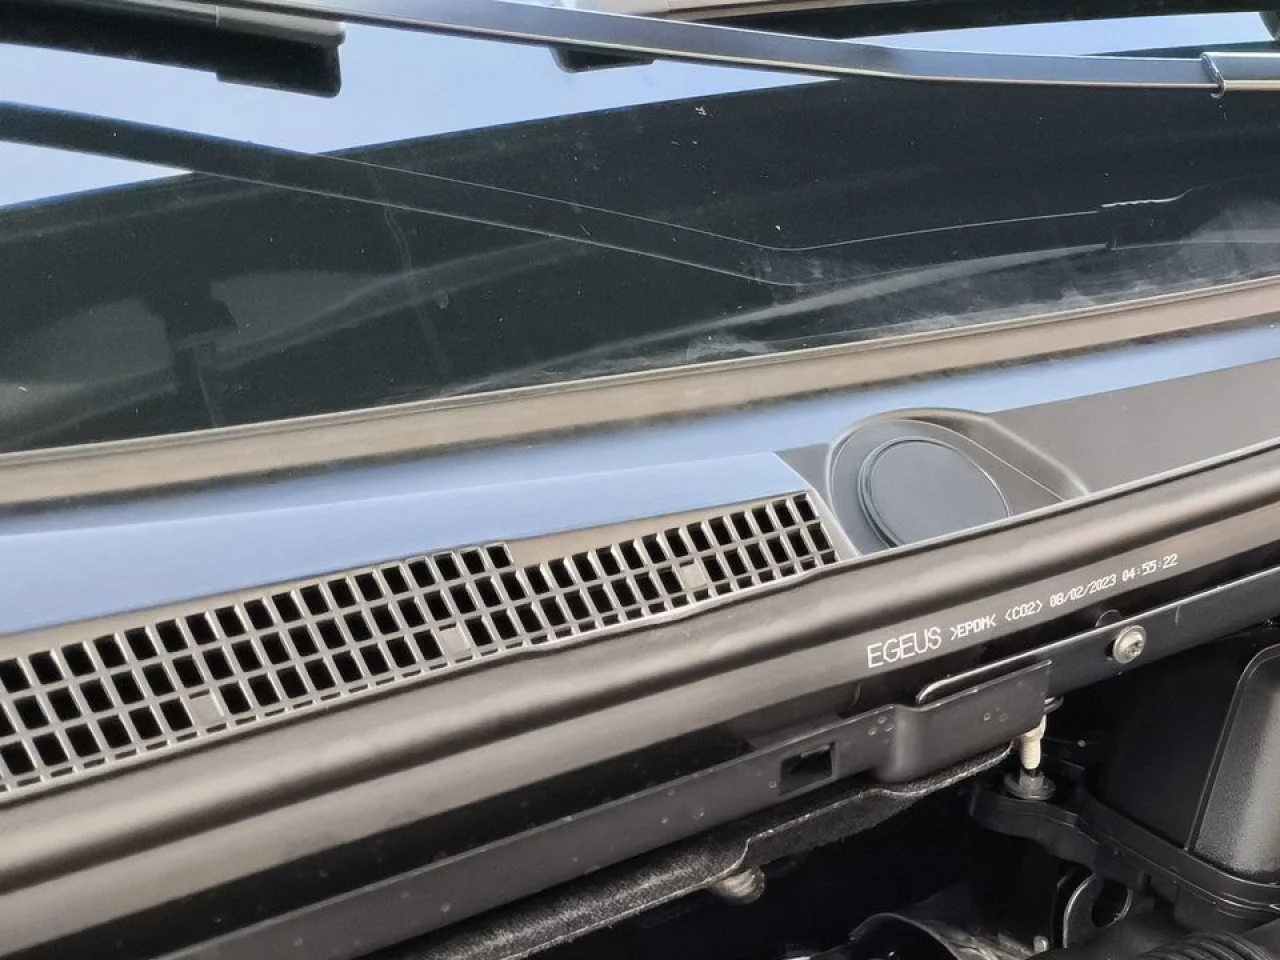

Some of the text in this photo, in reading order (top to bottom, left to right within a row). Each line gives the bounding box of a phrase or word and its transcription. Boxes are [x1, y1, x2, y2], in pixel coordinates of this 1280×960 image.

[867, 627, 942, 668] EGEUS
[951, 613, 996, 641] >EPDM<
[1050, 573, 1117, 608] 08/02/2023
[1122, 554, 1178, 581] 04:55:22
